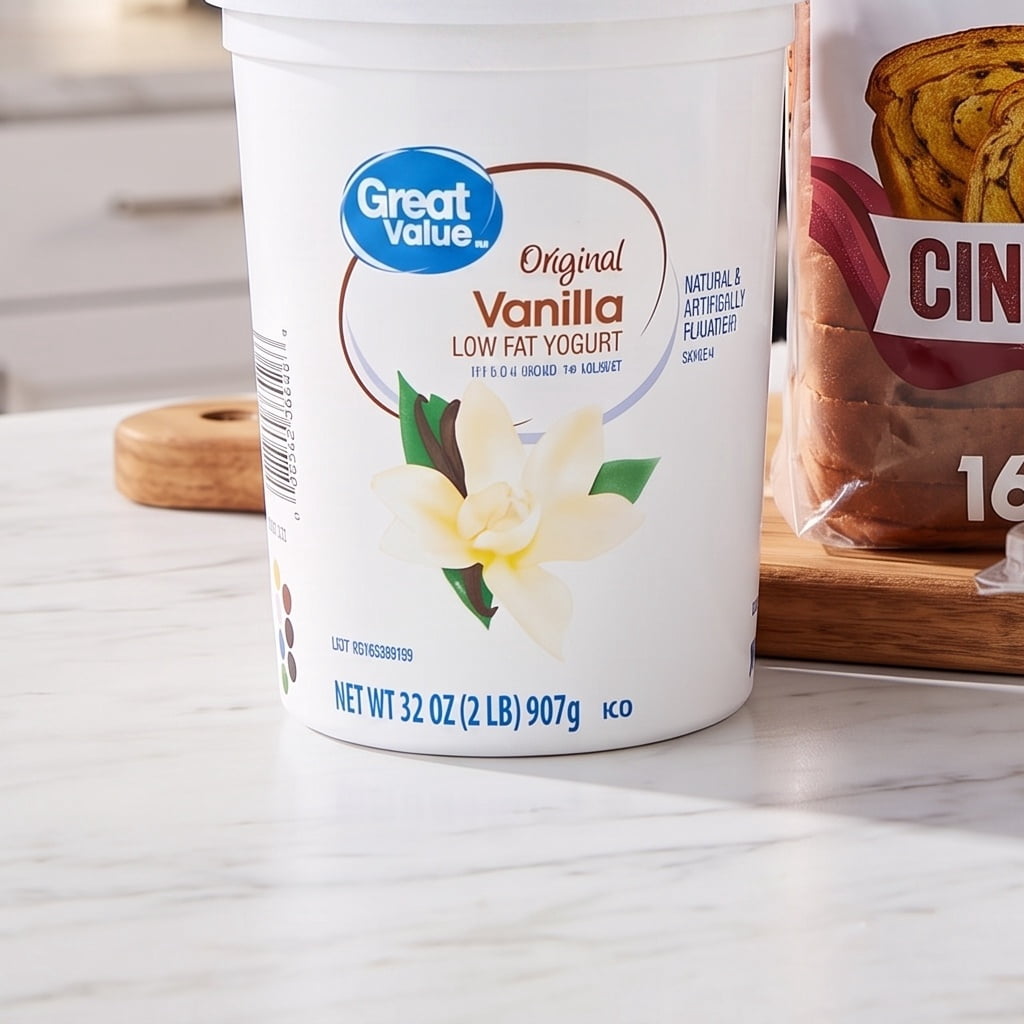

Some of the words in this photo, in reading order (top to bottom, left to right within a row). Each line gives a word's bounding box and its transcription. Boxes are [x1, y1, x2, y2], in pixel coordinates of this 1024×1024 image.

[357, 177, 471, 220] Great
[383, 219, 472, 247] Value
[520, 238, 625, 286] Original
[685, 270, 732, 294] NATURAL
[473, 289, 623, 328] Vanilla
[453, 336, 497, 357] LOW
[504, 335, 538, 357] FAT
[543, 330, 623, 356] YOGURT
[335, 680, 363, 715] NET
[368, 687, 395, 720] WT
[400, 692, 424, 723] 32
[430, 694, 456, 725] OZ
[460, 694, 480, 731] (2
[487, 694, 521, 731] LB)
[527, 695, 580, 732] 907g
